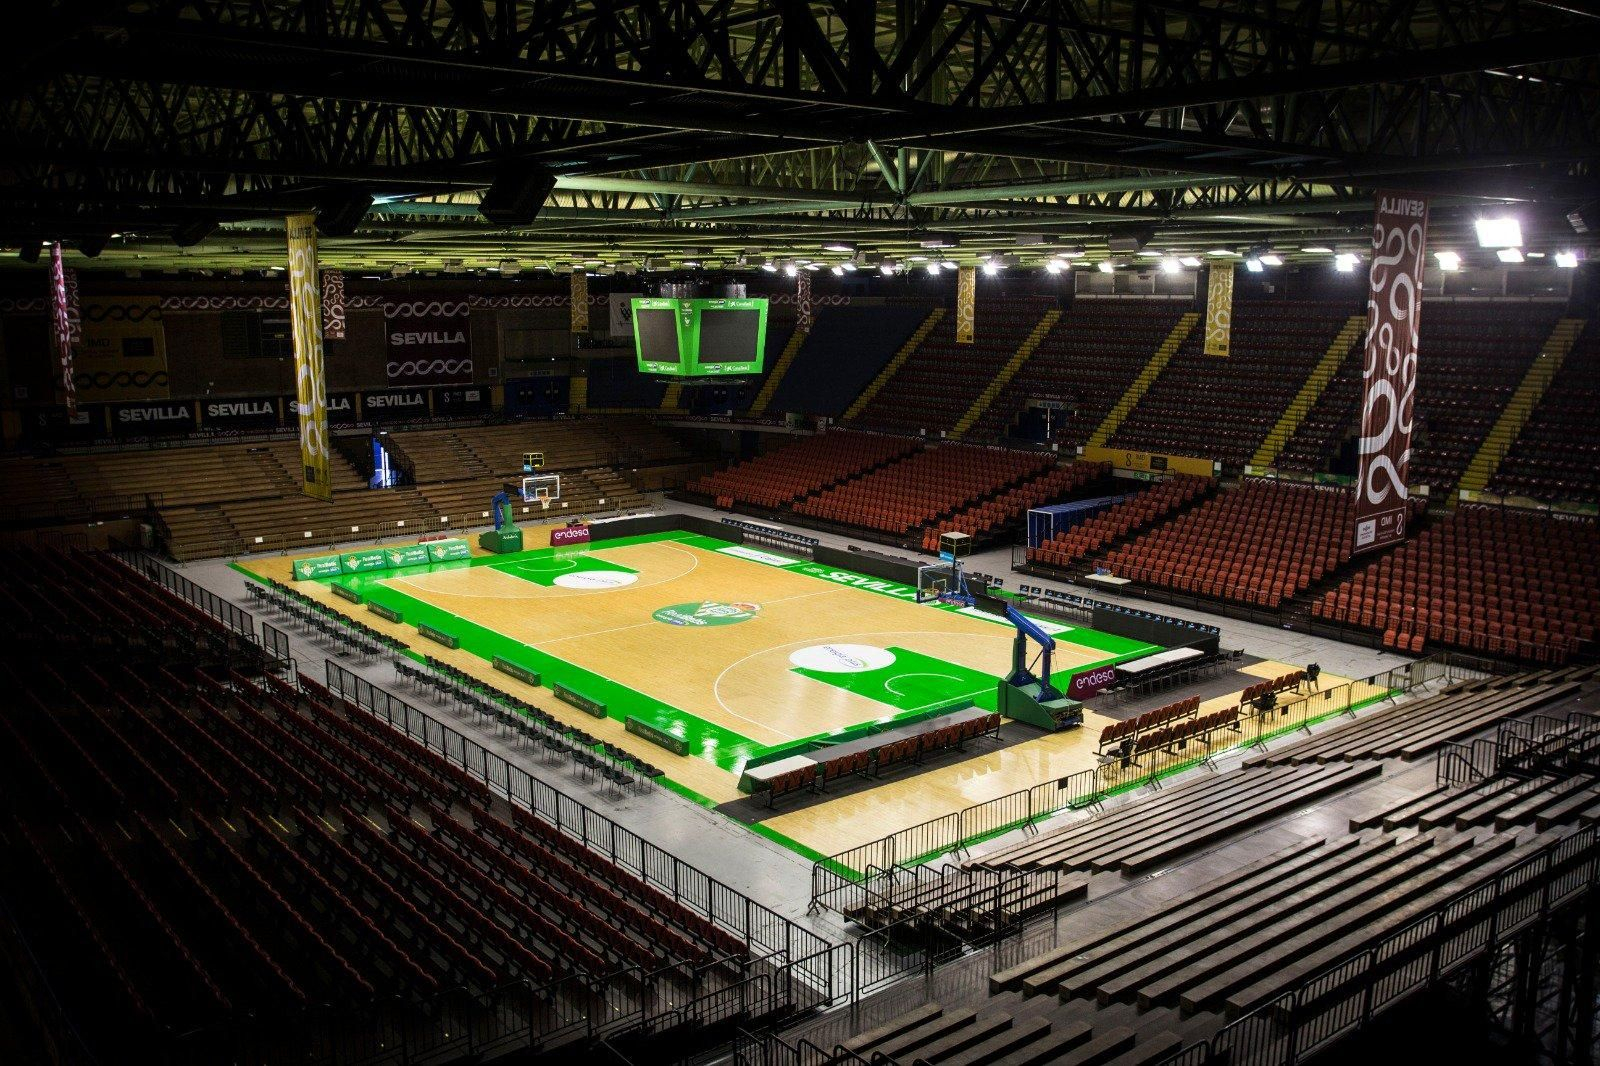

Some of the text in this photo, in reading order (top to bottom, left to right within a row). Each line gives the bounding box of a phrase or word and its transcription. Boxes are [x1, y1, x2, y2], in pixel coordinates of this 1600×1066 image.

[390, 332, 466, 345] SEVILLA
[366, 393, 424, 409] SEVILLA
[119, 406, 190, 421] SEVILLA
[207, 401, 273, 417] SEVILLA
[555, 528, 589, 540] endesa
[1076, 670, 1115, 690] endesa
